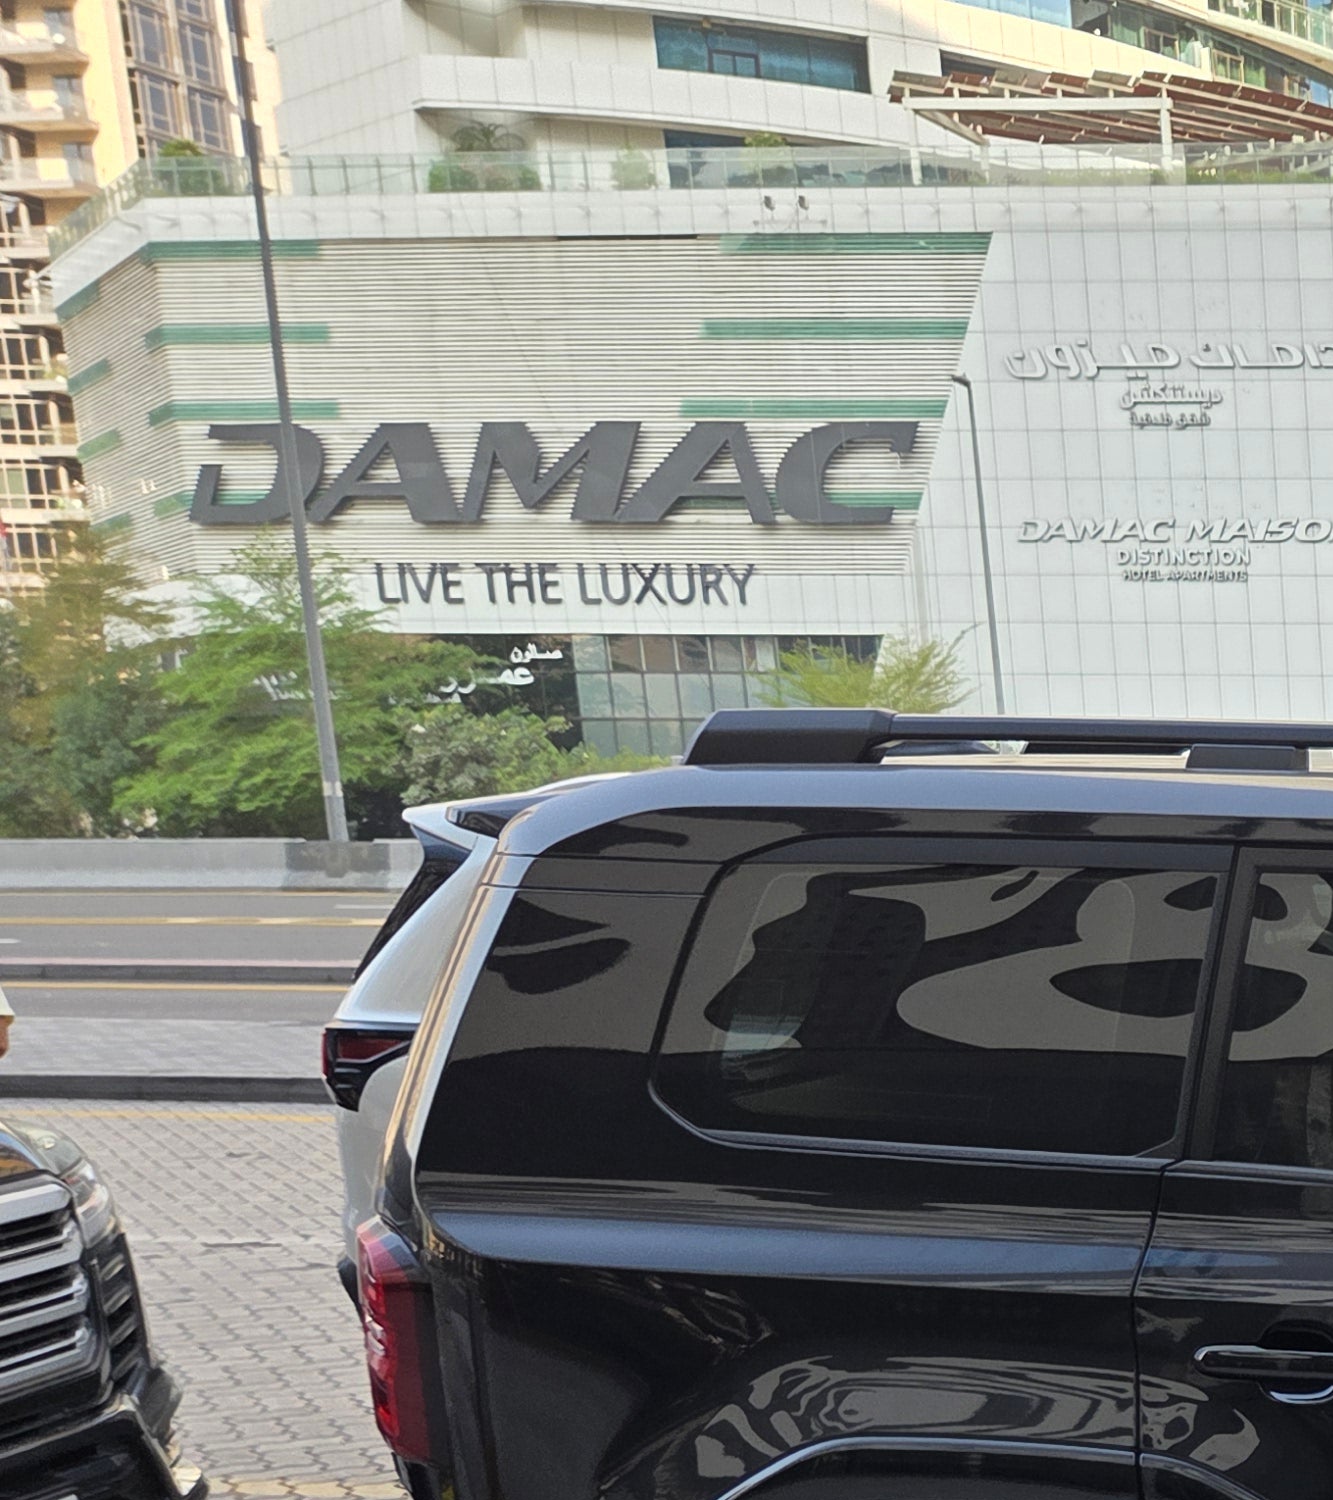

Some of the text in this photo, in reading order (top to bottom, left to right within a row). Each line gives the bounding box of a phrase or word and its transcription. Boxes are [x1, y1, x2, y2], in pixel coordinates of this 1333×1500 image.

[189, 421, 920, 526] DAMAC
[1017, 517, 1176, 544] DAMAC
[1116, 548, 1250, 566] DISTINCTION
[374, 562, 756, 606] LIVE THE LUXURY
[1123, 569, 1249, 583] HOTEL APARTMENTS
